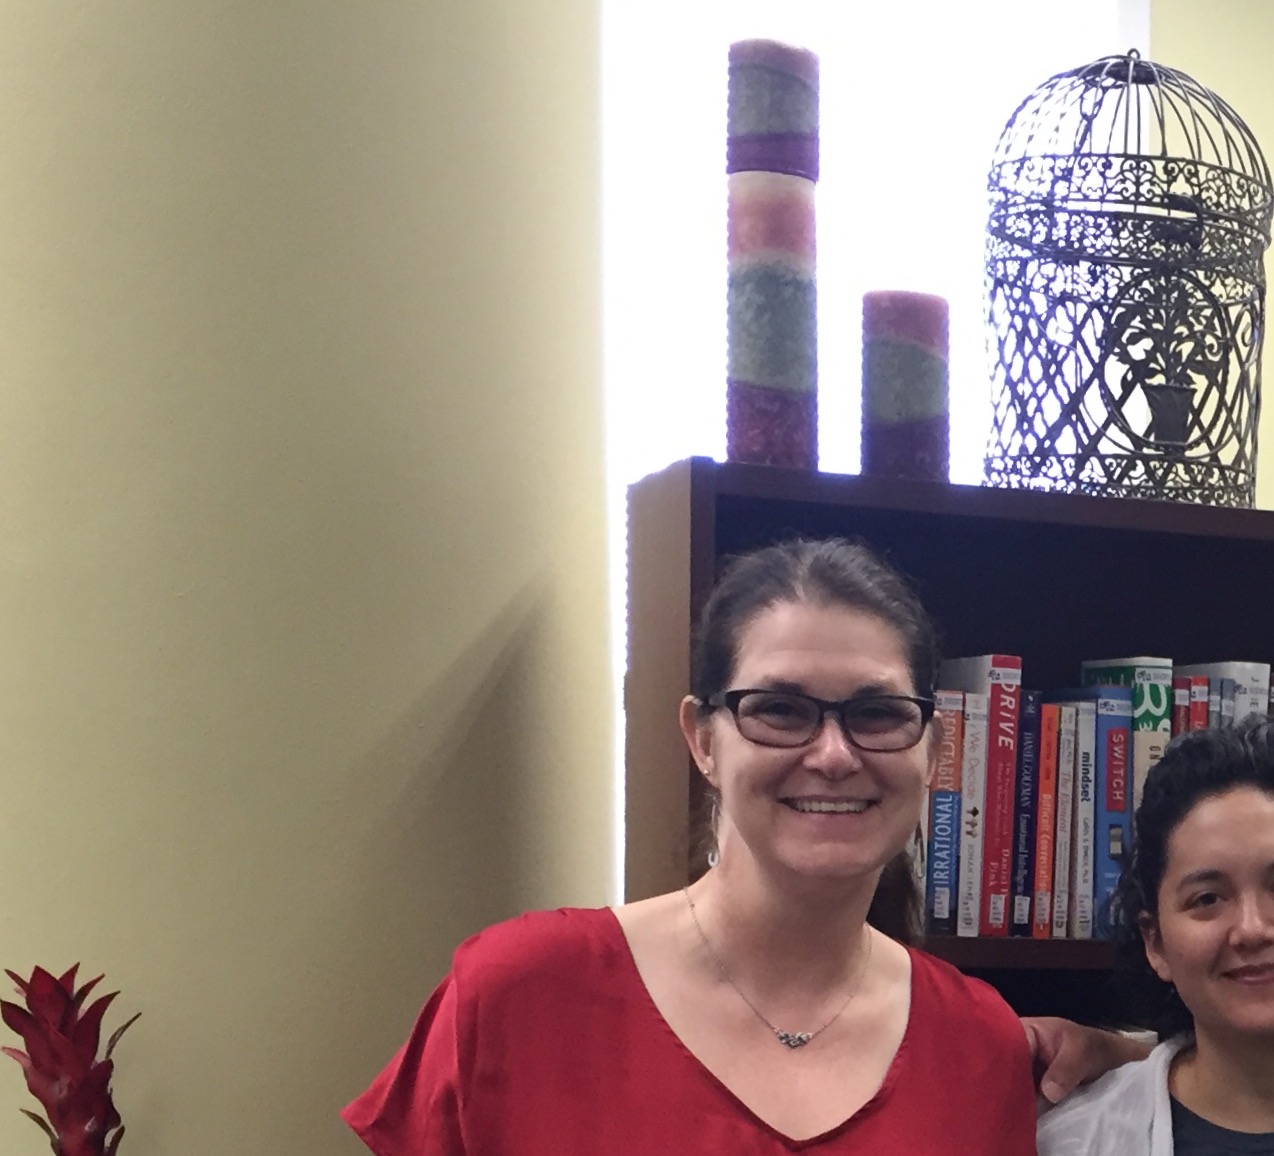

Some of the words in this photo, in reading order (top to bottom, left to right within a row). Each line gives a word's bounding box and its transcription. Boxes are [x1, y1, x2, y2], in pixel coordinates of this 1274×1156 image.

[968, 732, 981, 753] We
[1111, 733, 1125, 801] SWITCH
[966, 756, 979, 799] Decide
[1080, 751, 1092, 803] mindset
[933, 795, 953, 890] IRRATIONAL
